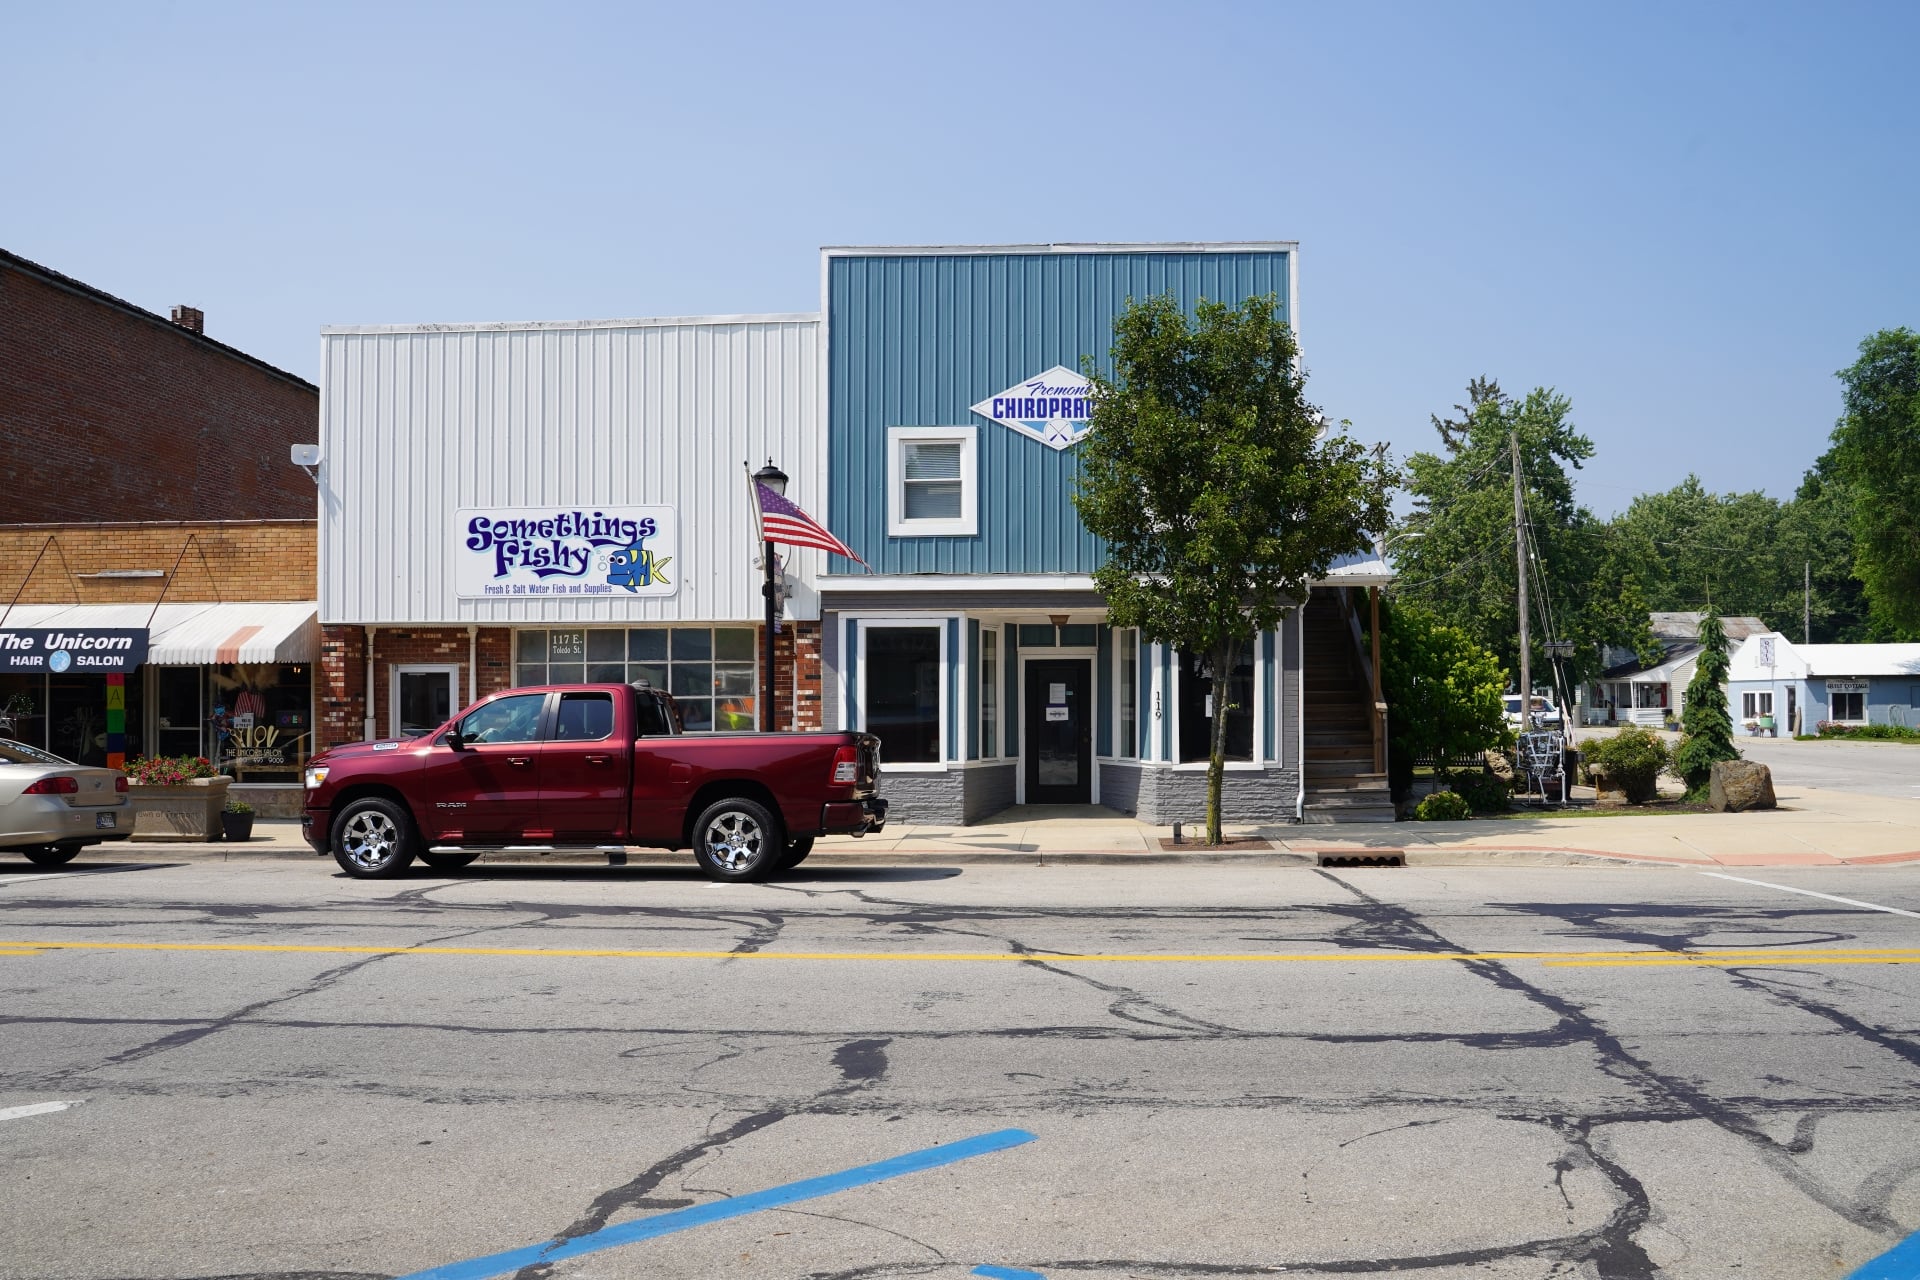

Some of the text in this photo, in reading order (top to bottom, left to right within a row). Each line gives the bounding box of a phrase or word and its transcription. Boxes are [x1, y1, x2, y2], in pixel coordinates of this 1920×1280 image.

[1026, 381, 1093, 397] Fremont
[993, 398, 1097, 419] CHIROPRAC
[466, 511, 656, 551] Somethings
[494, 540, 592, 578] Fishy
[484, 583, 612, 594] Fresh & Salt Water Fish and Supplies
[0, 633, 133, 650] The Unicorn
[552, 634, 583, 644] 117 E.
[552, 645, 582, 654] Toledo St.
[10, 656, 124, 666] HAIR SALON
[226, 749, 236, 757] THE
